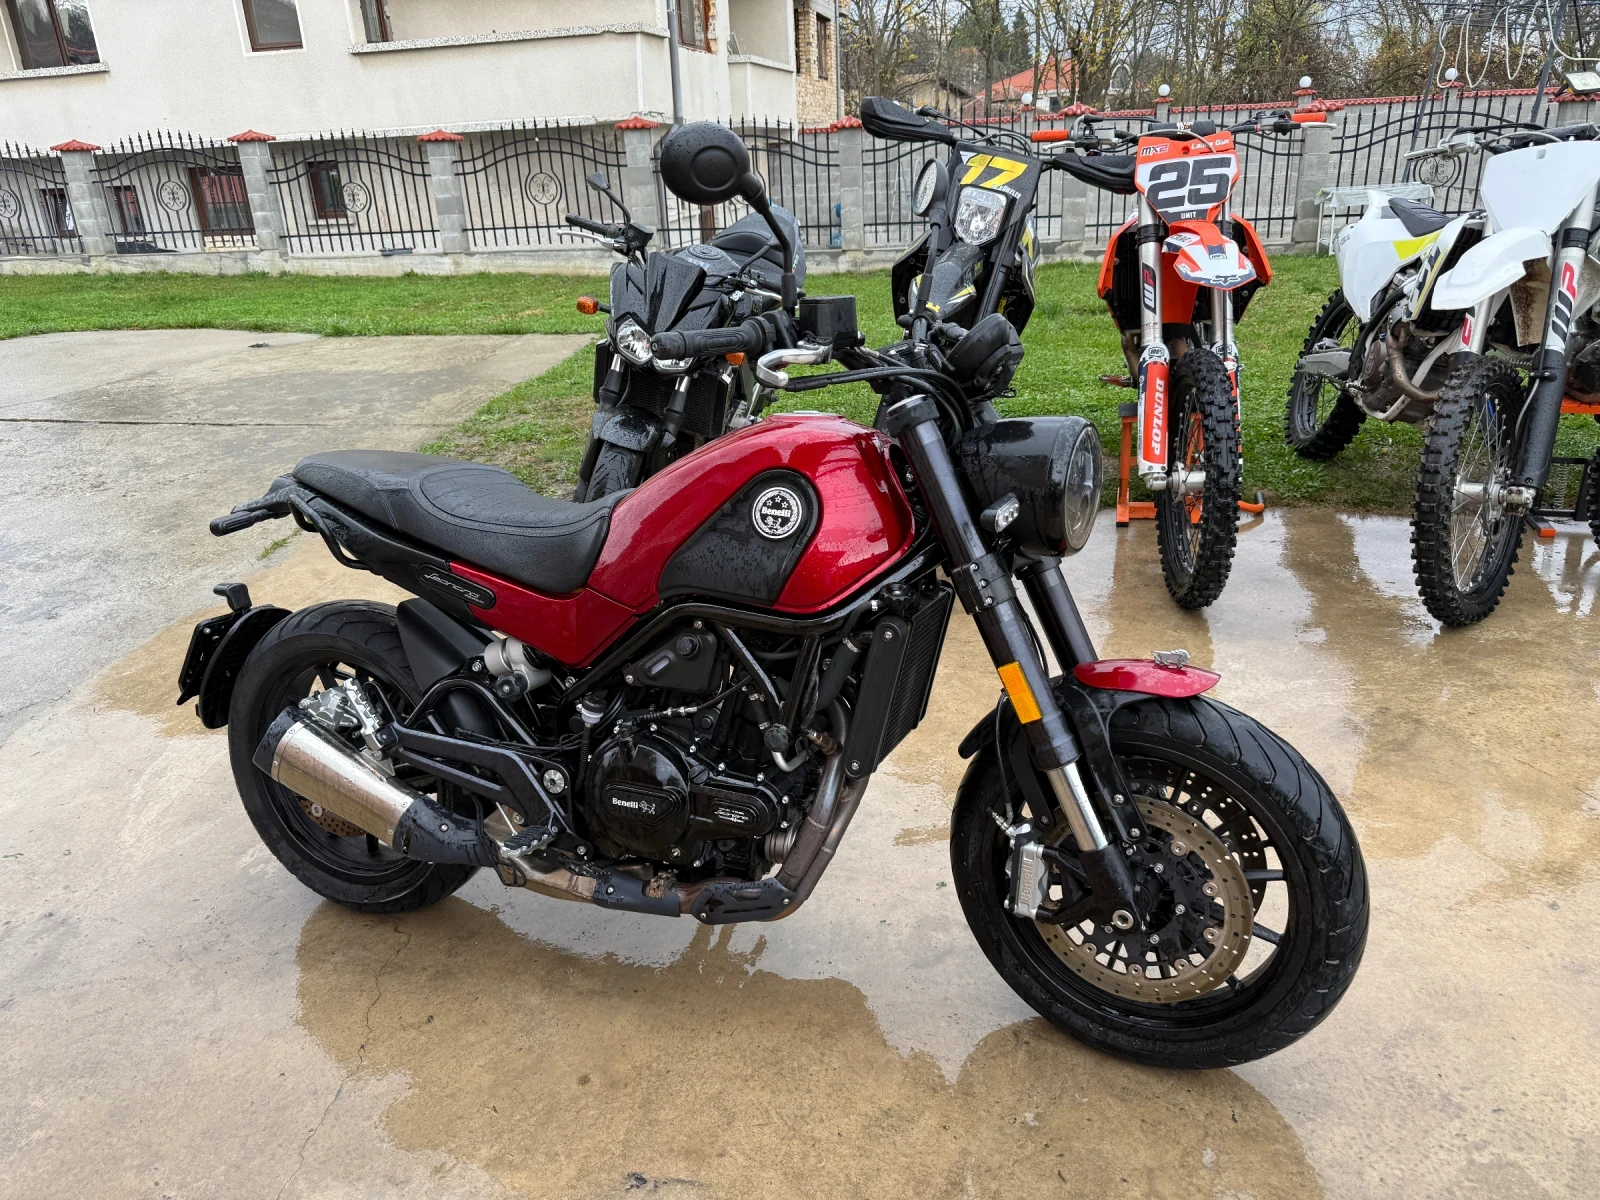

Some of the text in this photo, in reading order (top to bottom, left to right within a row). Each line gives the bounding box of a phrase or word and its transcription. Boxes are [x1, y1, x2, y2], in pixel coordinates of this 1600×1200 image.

[1140, 143, 1169, 157] MX2
[959, 153, 1028, 188] 17
[1146, 157, 1232, 210] 25
[1180, 211, 1197, 219] UNIT
[1551, 261, 1577, 346] WP
[1152, 377, 1164, 456] DUNLOP
[761, 506, 791, 518] Benelli
[612, 797, 638, 809] Benelli
[1020, 860, 1034, 905] Benelli
